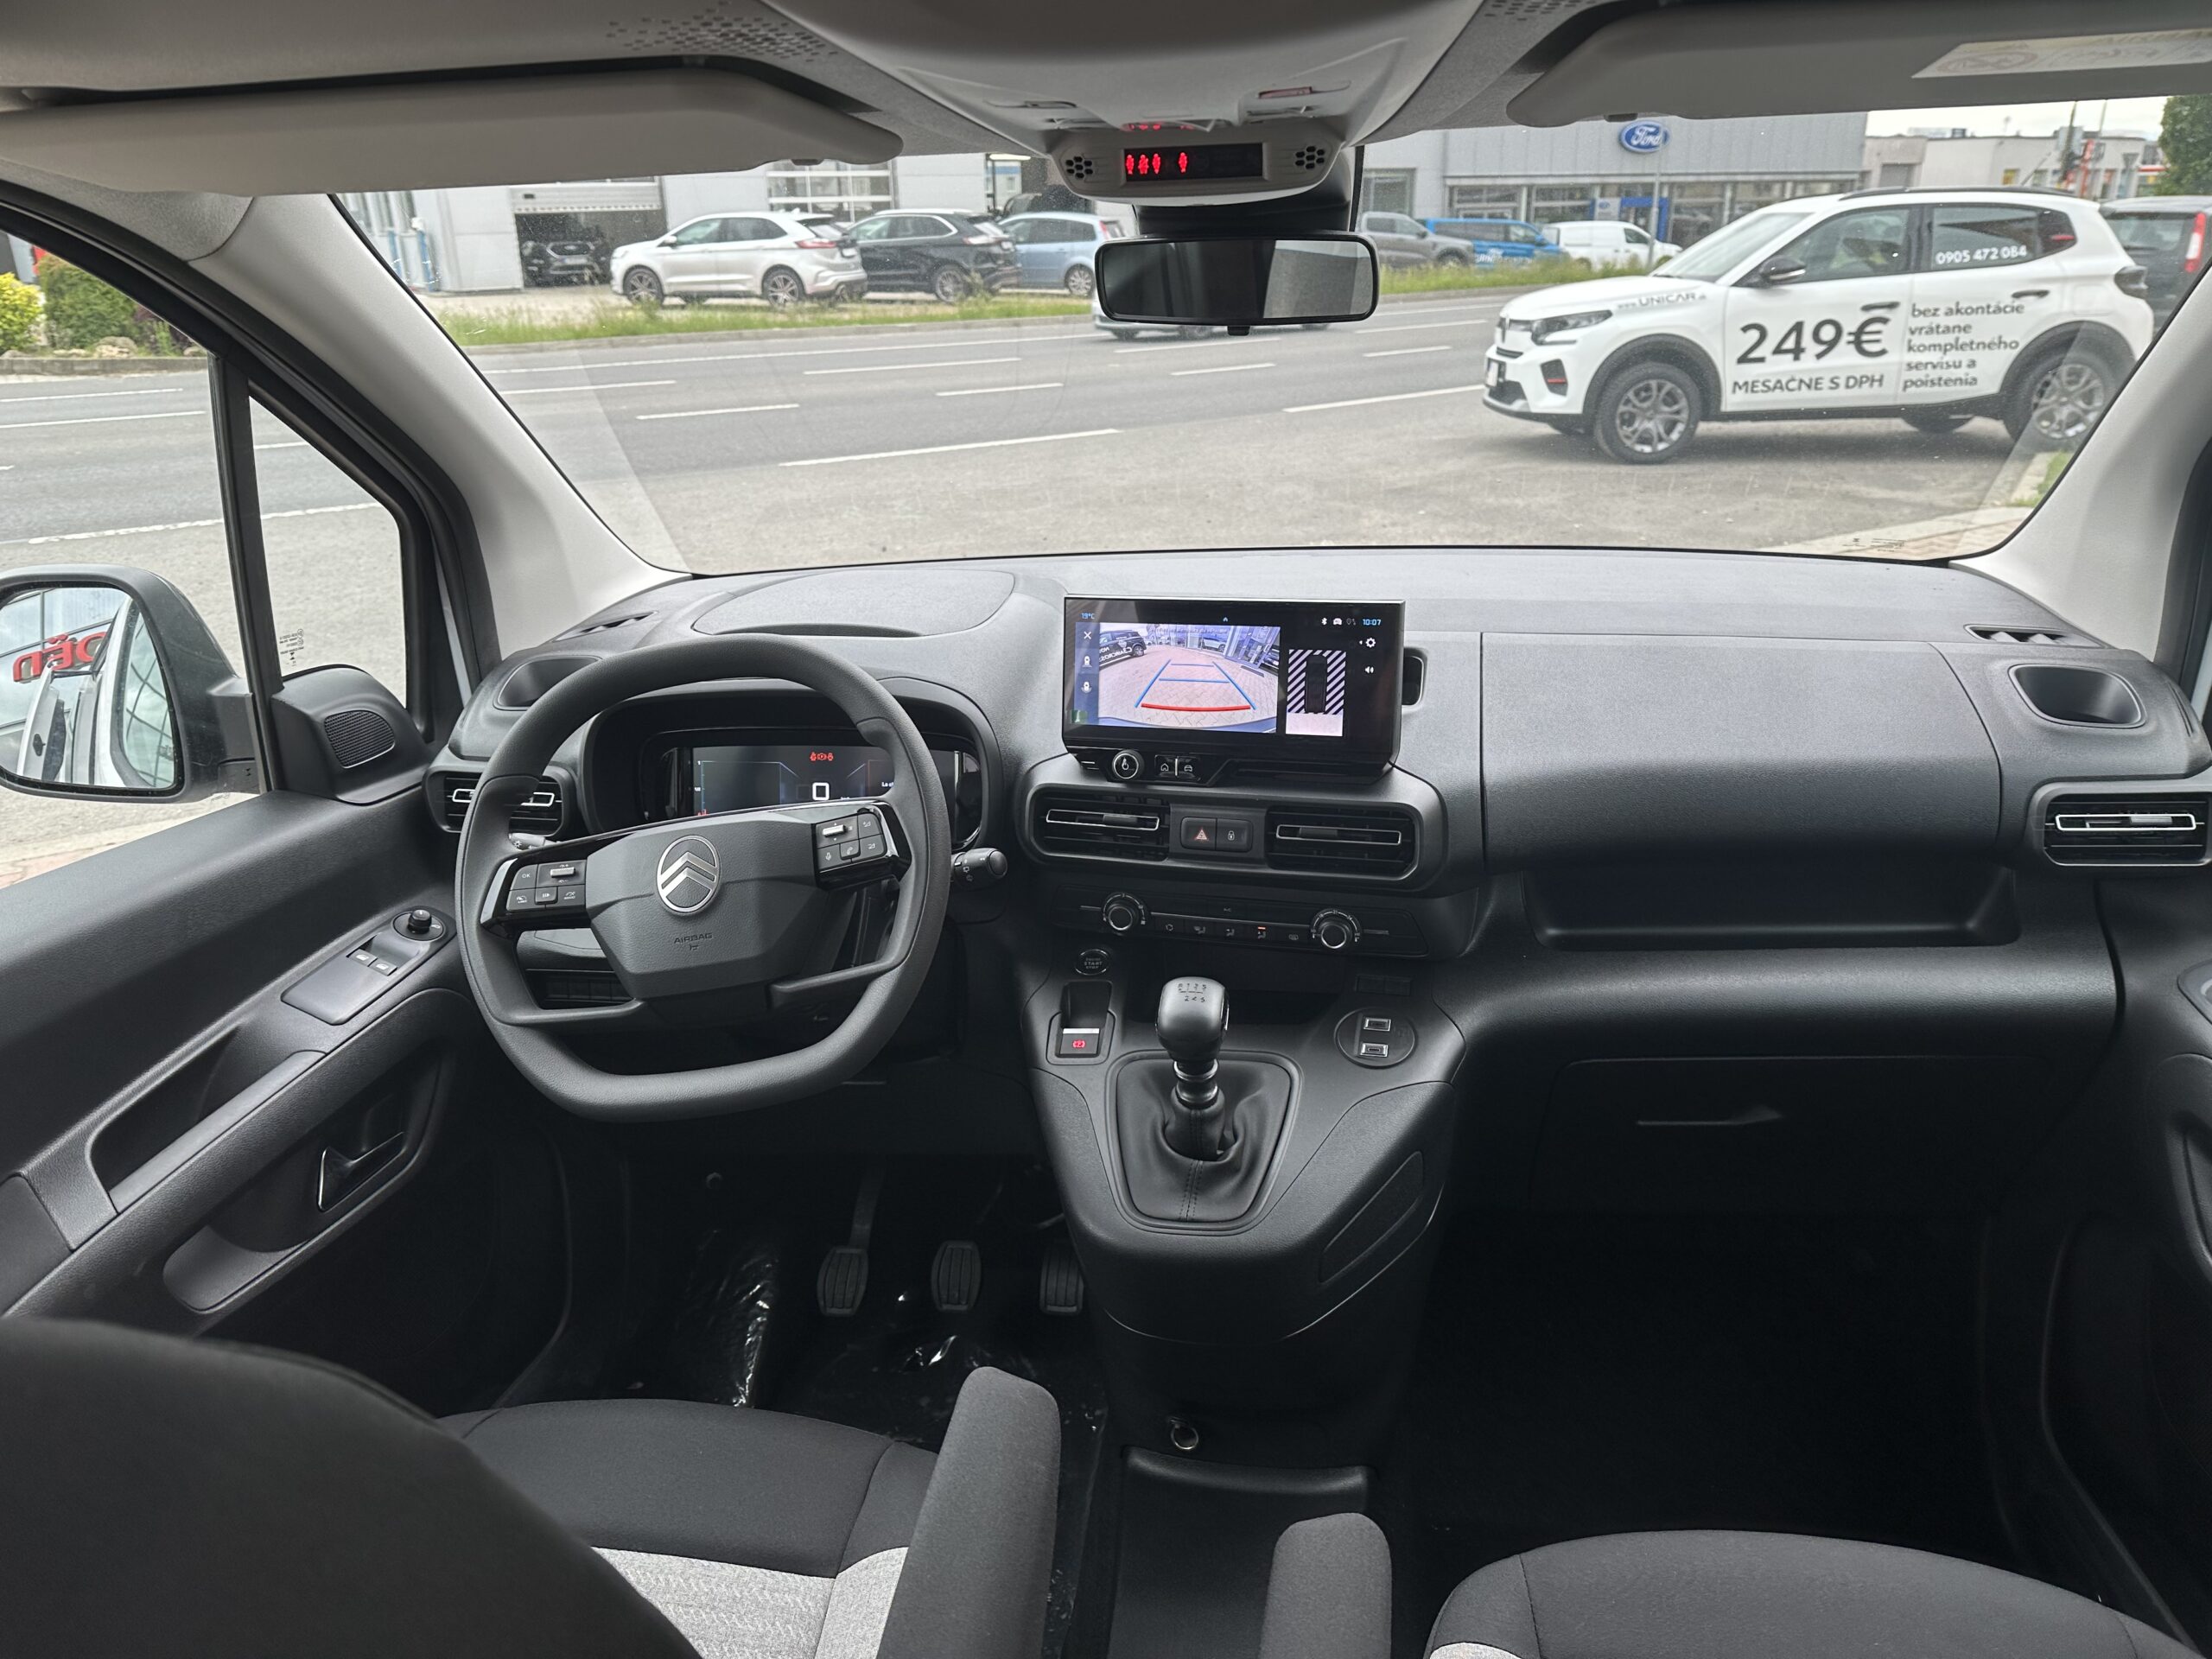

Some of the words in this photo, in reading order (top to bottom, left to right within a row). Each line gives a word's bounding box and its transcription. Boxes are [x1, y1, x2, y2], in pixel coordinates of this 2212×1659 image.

[1936, 250, 1970, 264] 0905
[1973, 247, 1999, 260] 472
[1911, 303, 1940, 317] bez
[1944, 300, 2025, 315] akontácie
[1909, 321, 1973, 336] vrátane
[1736, 316, 1891, 365] 249€
[1907, 335, 2020, 355] kompletného
[1905, 356, 1962, 372] servisu
[1966, 359, 1977, 369] a
[1828, 376, 1840, 391] S
[1845, 374, 1885, 389] DPH
[1903, 373, 1978, 391] poistenia
[812, 782, 830, 801] 0
